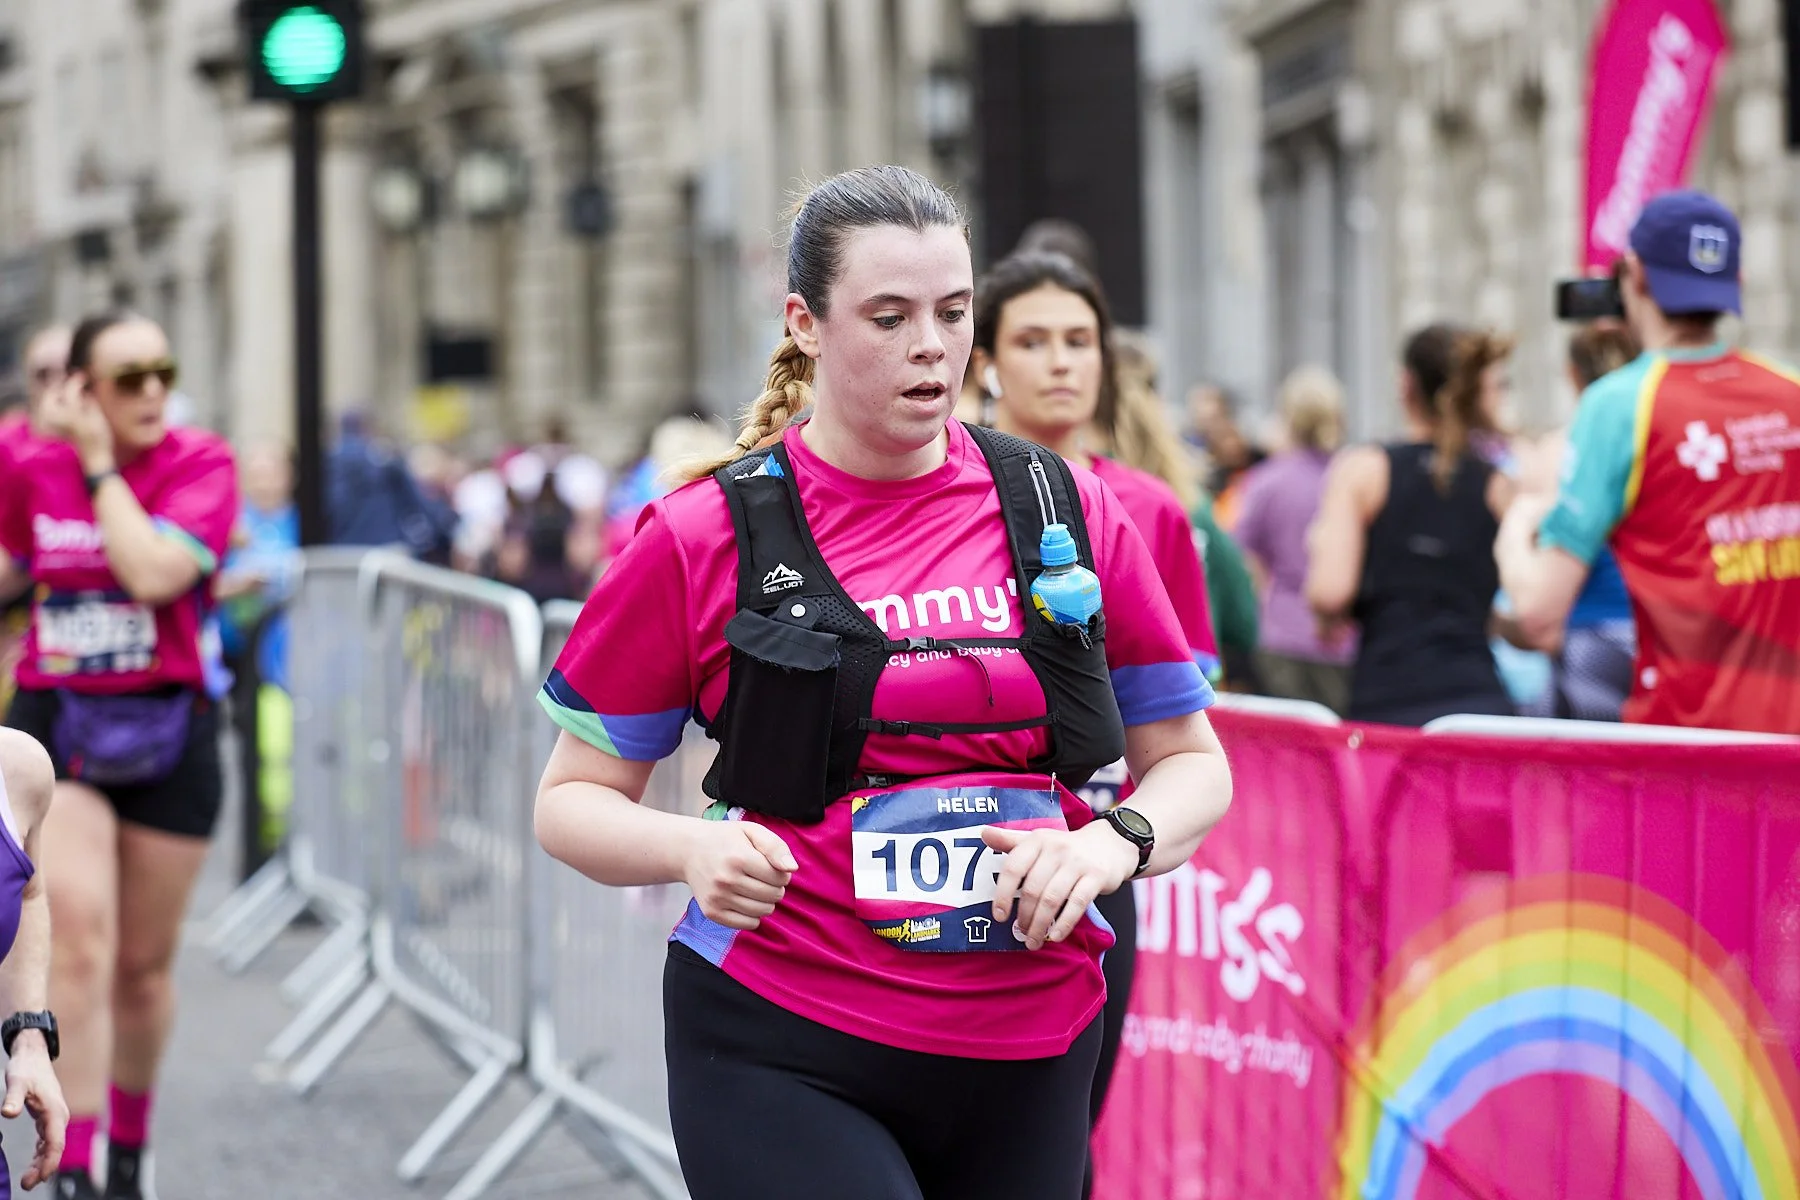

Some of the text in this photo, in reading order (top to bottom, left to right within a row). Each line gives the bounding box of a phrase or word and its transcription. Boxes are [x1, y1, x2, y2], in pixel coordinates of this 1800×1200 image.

[856, 578, 1018, 633] mmy'
[937, 797, 999, 813] HELEN
[871, 837, 1026, 893] 107
[872, 926, 902, 937] LONDON
